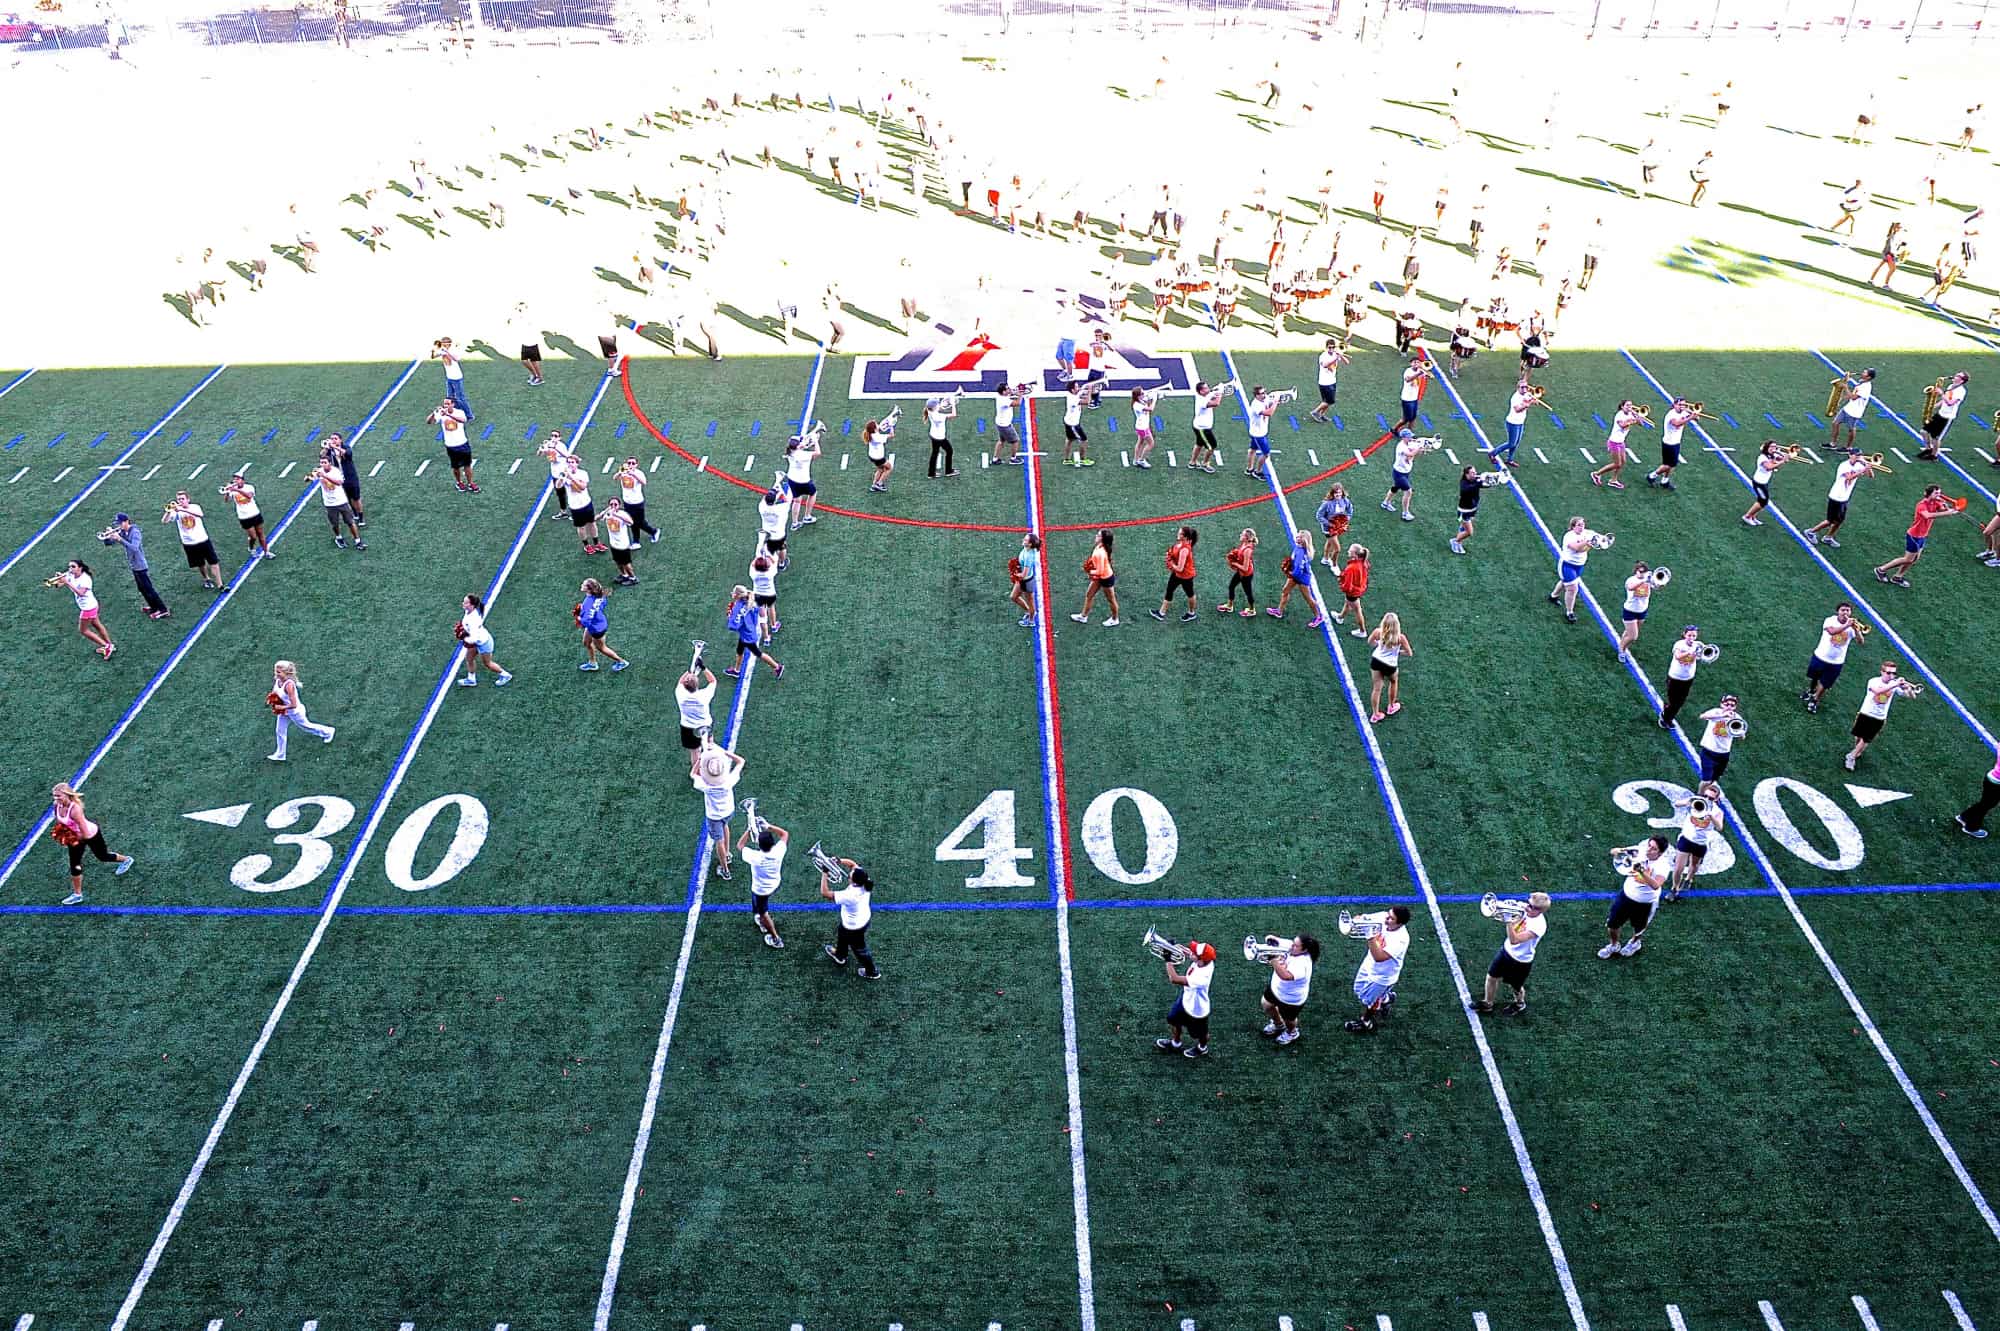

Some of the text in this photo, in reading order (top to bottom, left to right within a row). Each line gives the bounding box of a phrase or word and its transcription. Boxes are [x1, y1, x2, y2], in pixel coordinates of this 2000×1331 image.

[229, 794, 489, 893] 30
[935, 787, 1179, 888] 40
[1612, 777, 1865, 875] 30
